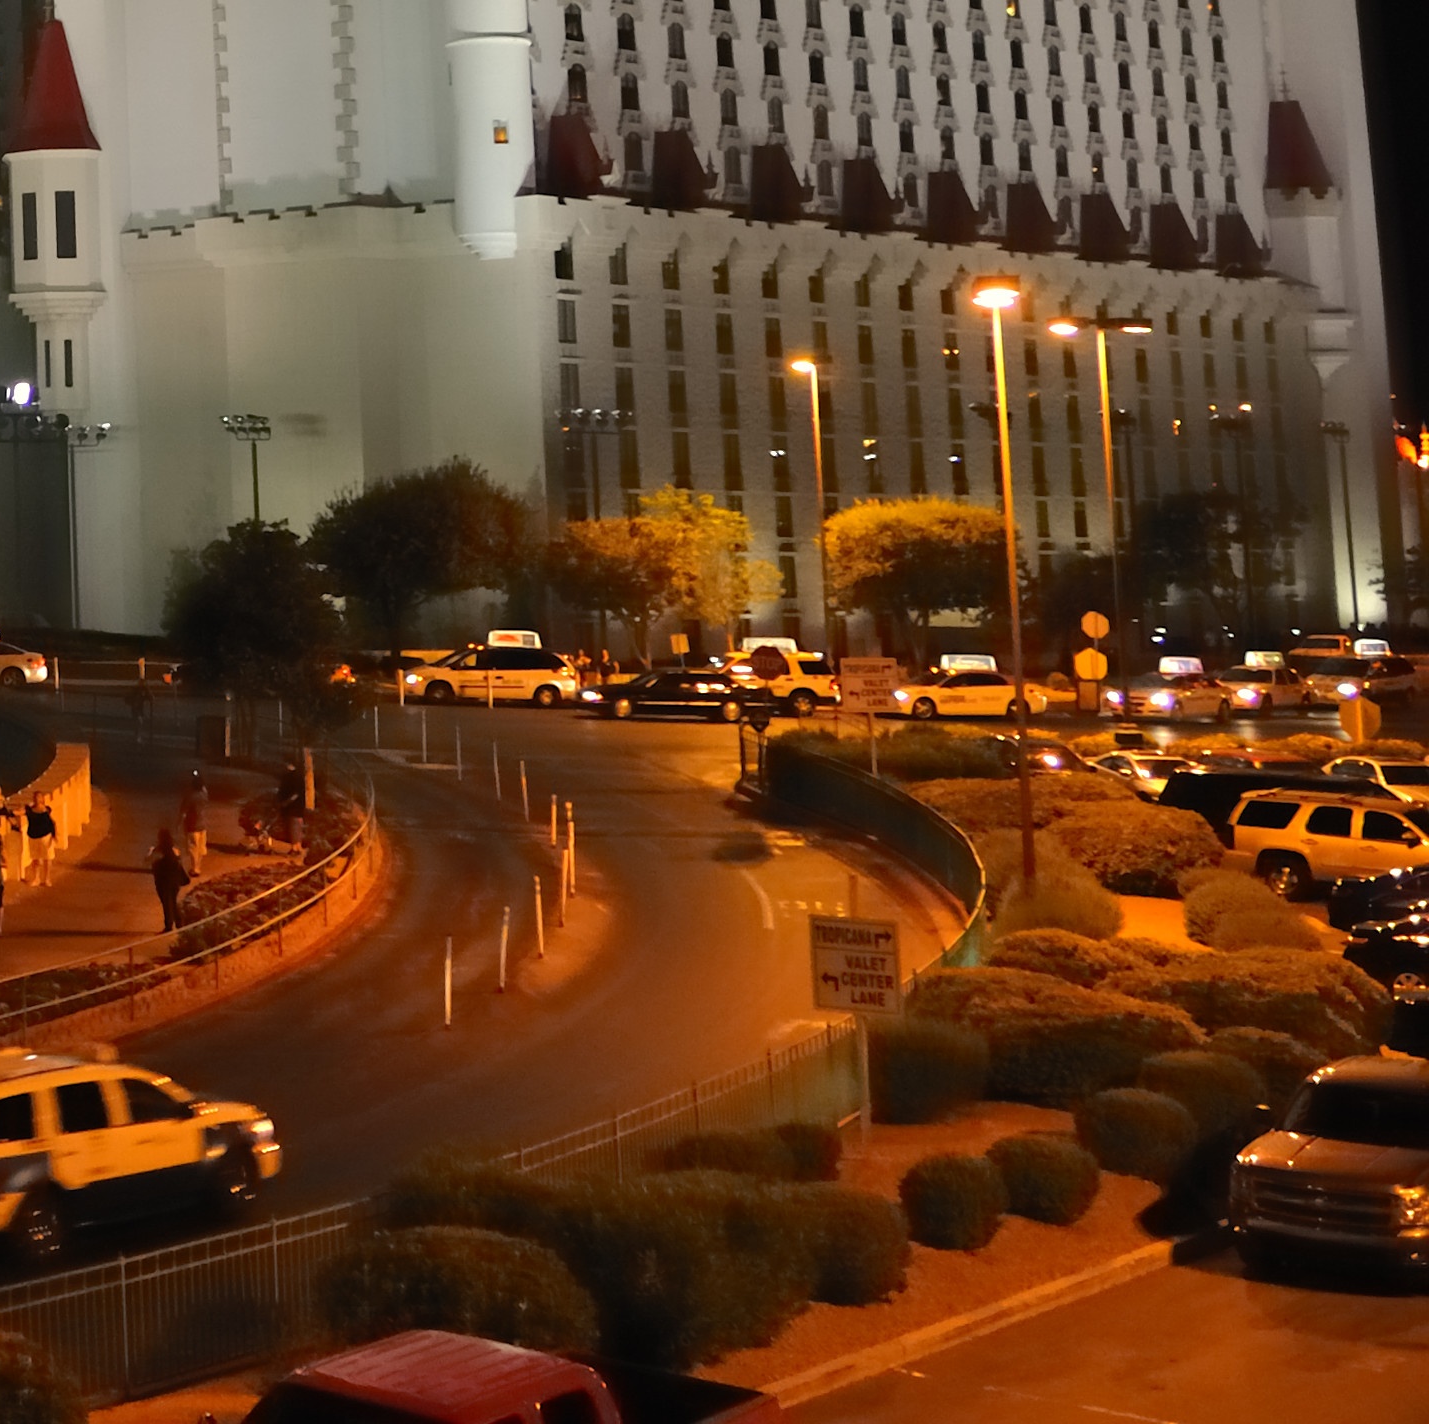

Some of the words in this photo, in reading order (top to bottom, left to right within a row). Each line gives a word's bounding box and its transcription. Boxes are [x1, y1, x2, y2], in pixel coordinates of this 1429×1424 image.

[814, 925, 872, 946] TROPICANA
[844, 955, 887, 972] VALET
[841, 971, 894, 990] CENTER
[850, 989, 886, 1008] LANE
